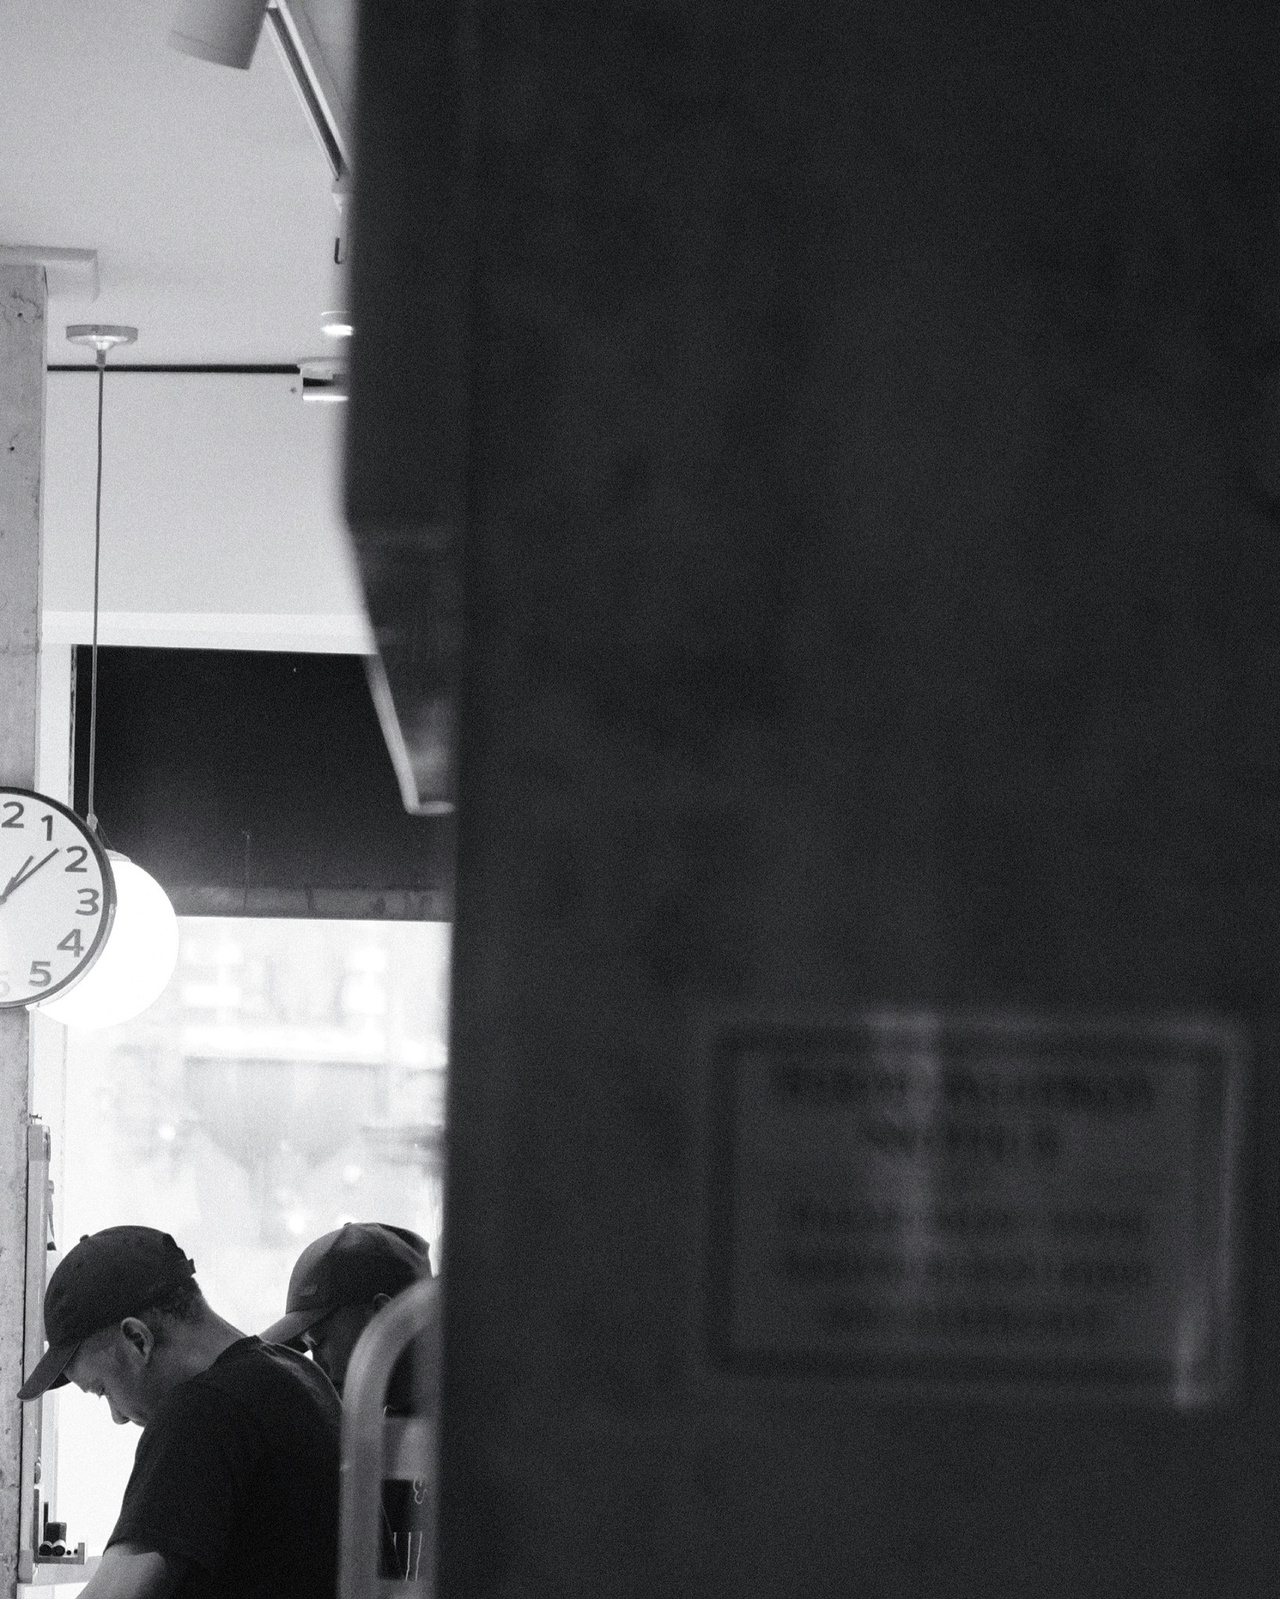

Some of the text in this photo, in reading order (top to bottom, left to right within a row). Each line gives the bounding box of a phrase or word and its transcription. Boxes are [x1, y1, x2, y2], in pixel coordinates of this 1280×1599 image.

[40, 814, 53, 841] 1
[65, 845, 88, 872] 2
[75, 888, 99, 916] 3
[56, 928, 84, 957] 4
[29, 960, 52, 987] 5
